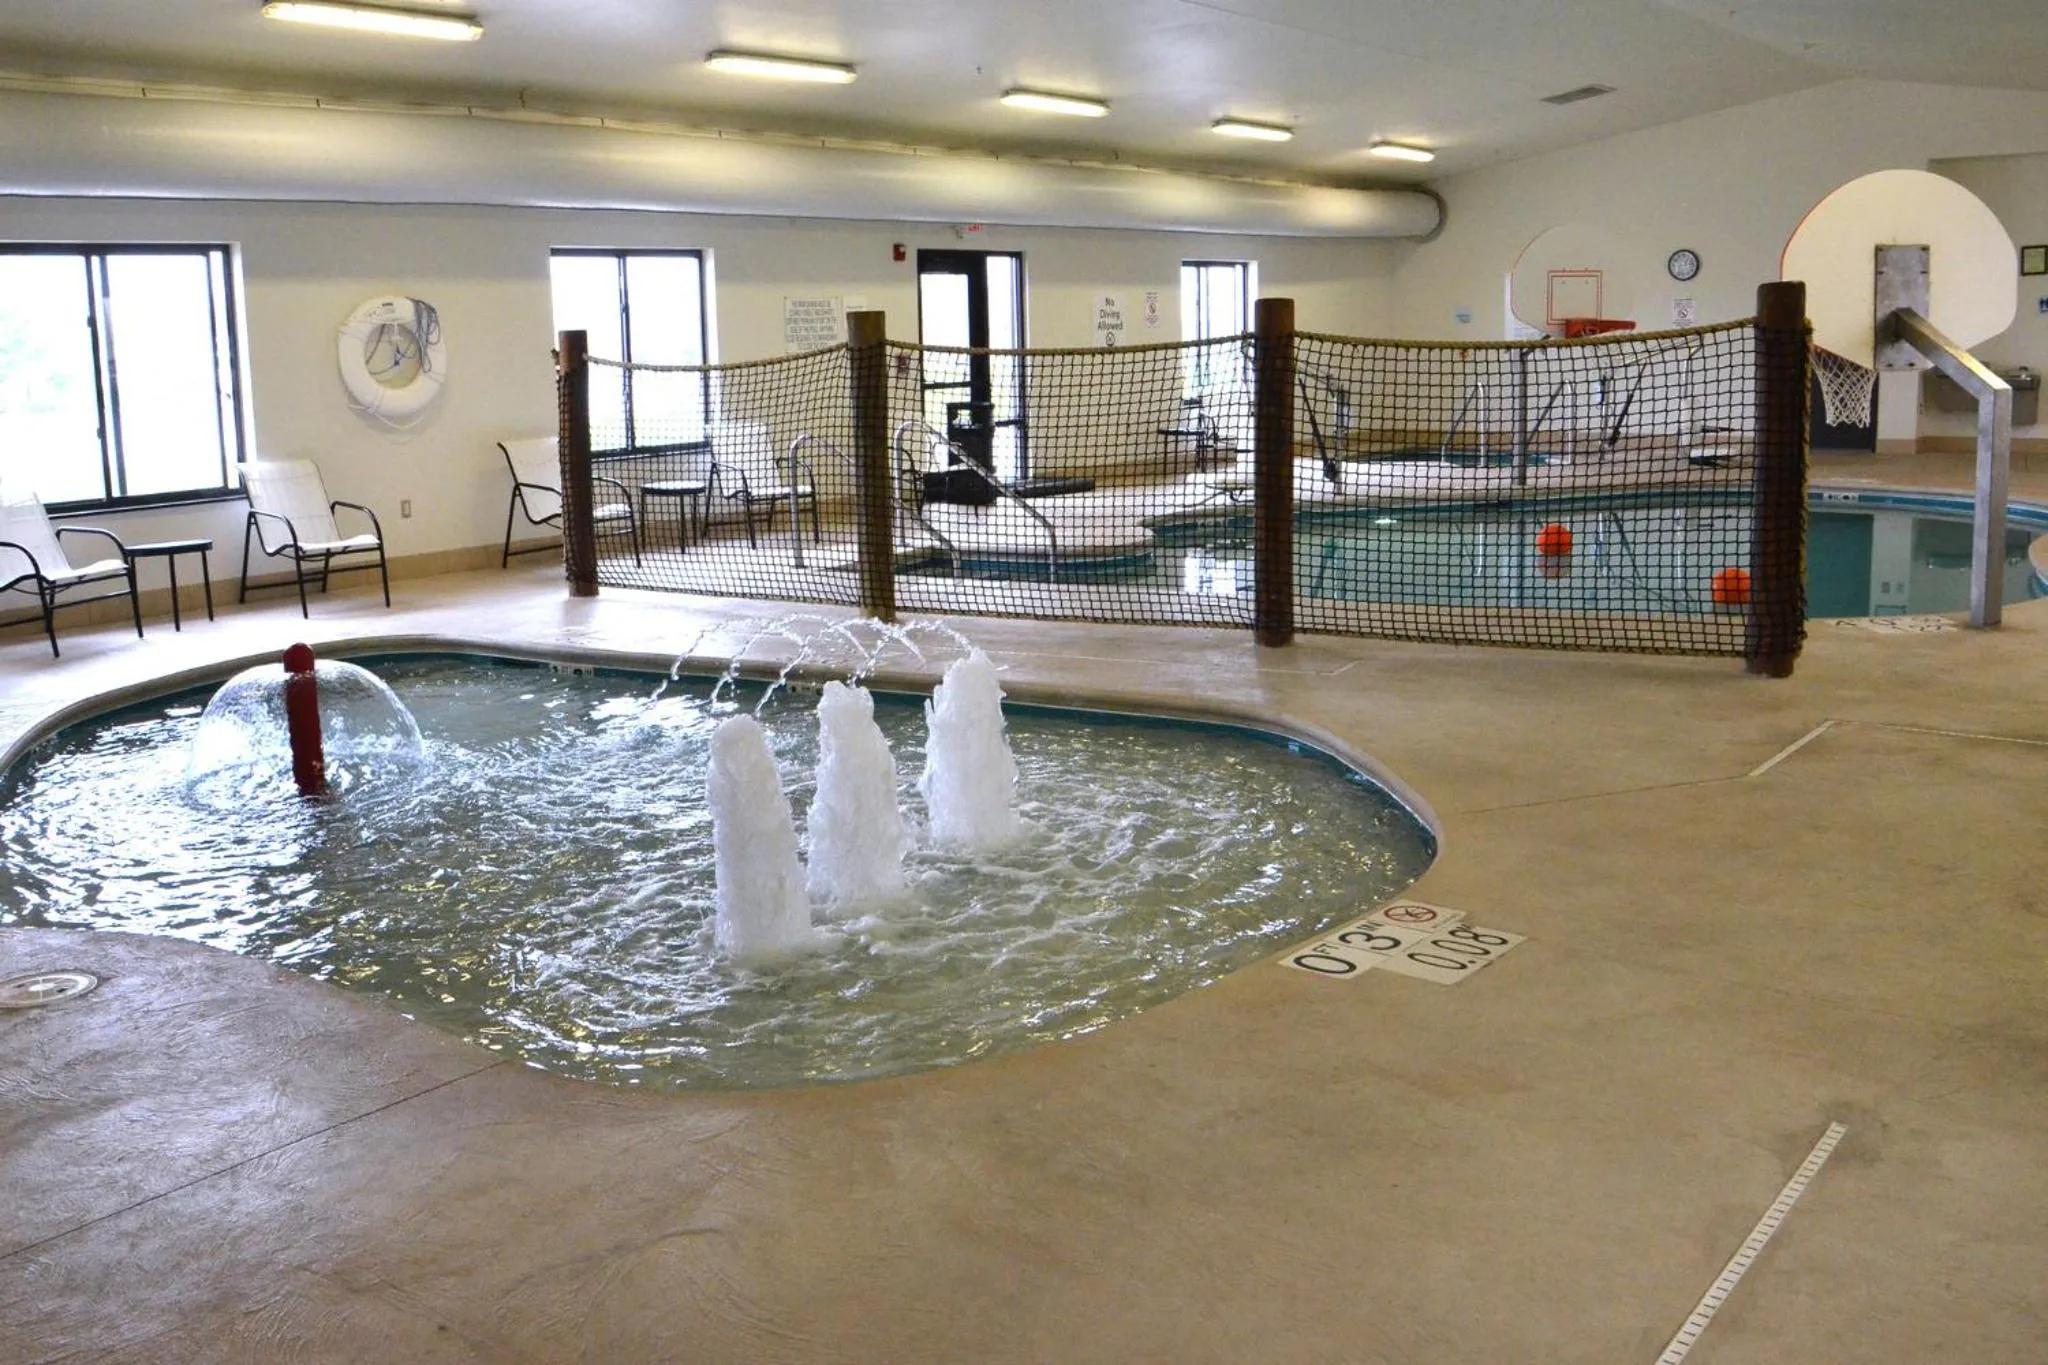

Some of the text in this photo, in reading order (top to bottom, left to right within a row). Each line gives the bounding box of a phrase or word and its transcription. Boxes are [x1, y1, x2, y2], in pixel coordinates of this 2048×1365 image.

[1105, 297, 1115, 306] No
[1097, 320, 1123, 331] Allowed
[1293, 954, 1357, 974] 0
[1338, 931, 1402, 951] 3
[1407, 929, 1509, 970] 0.08
